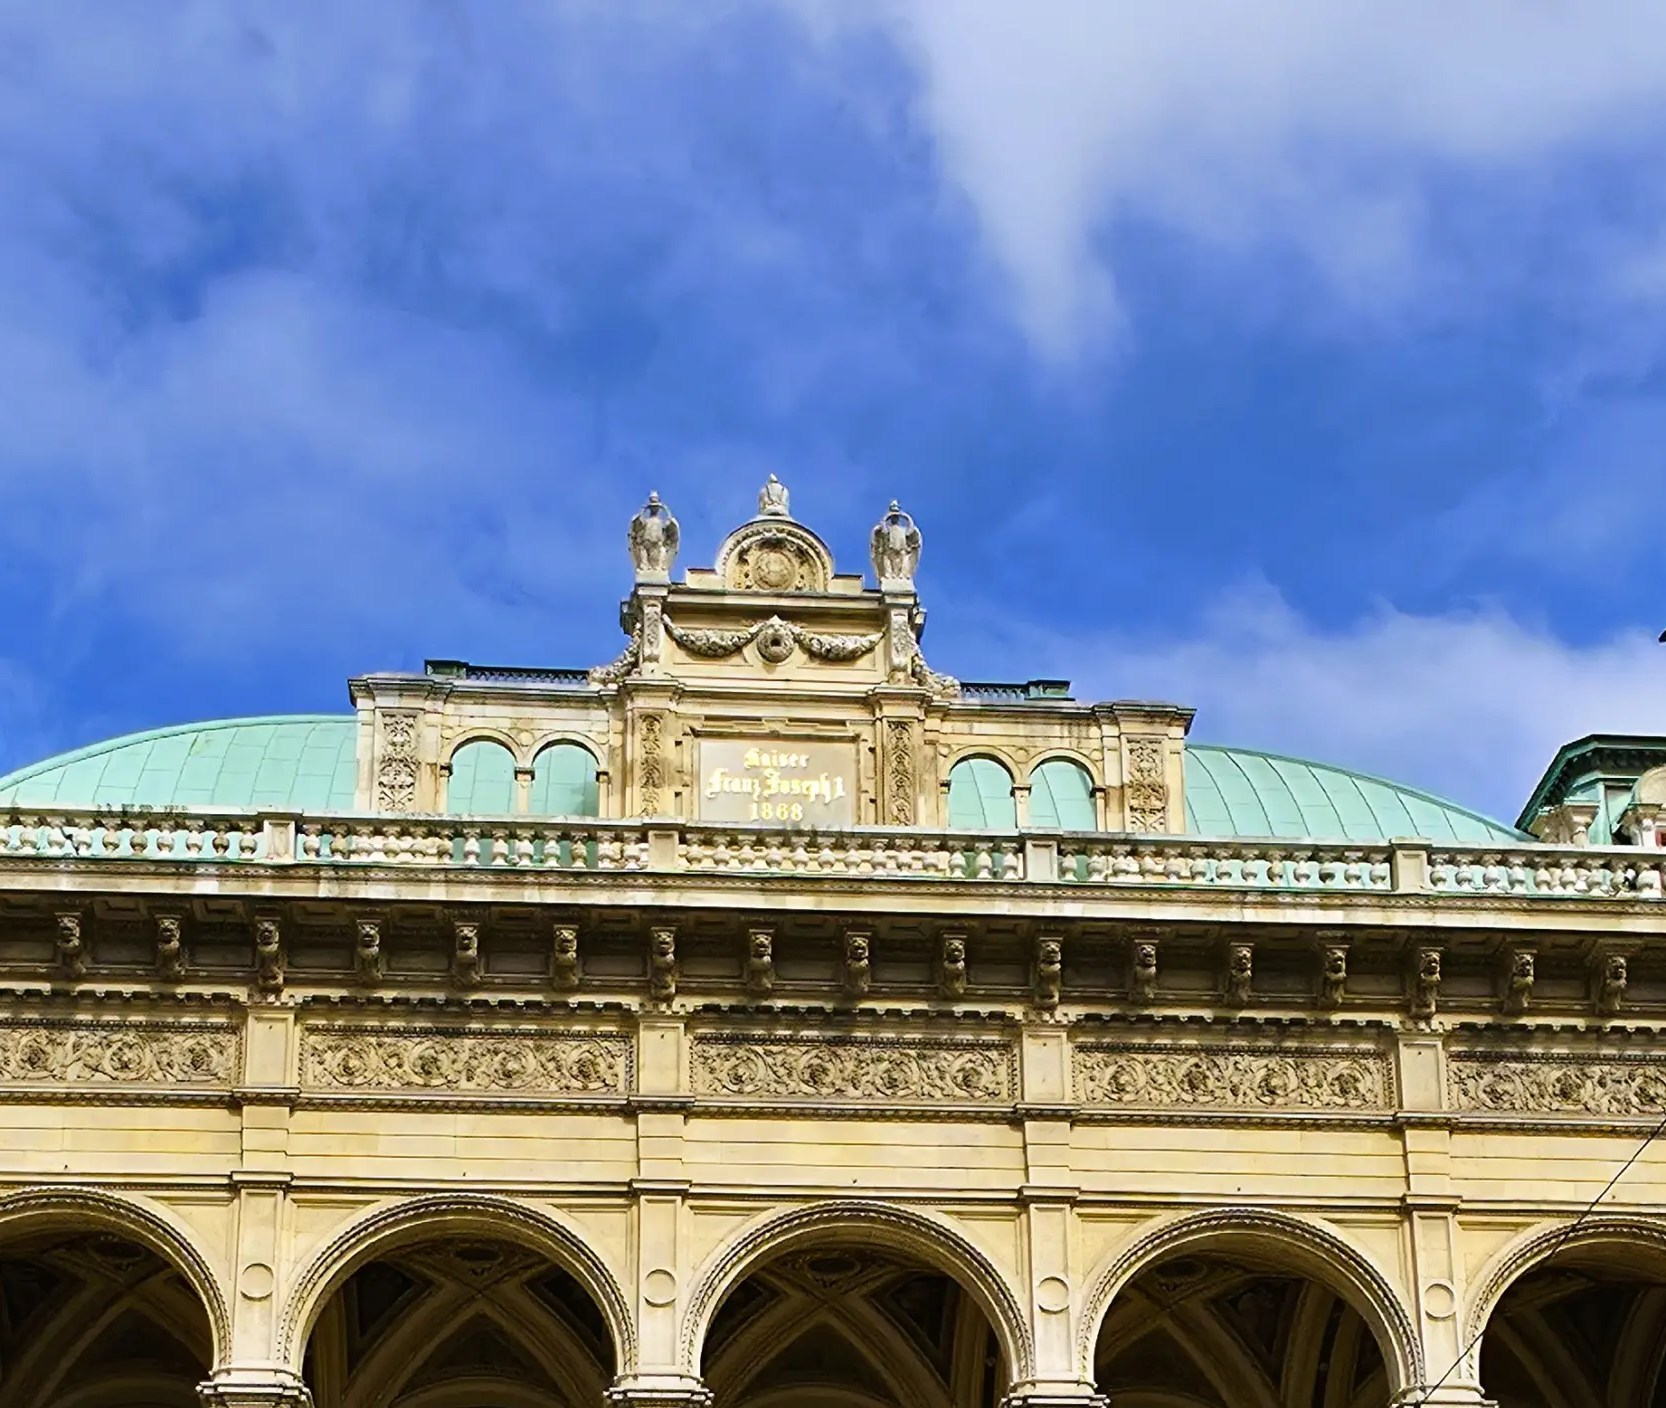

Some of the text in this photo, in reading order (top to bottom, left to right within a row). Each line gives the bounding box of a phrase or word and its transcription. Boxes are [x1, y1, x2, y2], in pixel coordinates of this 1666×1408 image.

[743, 748, 810, 769] Kaiser
[705, 767, 761, 800] Franz
[763, 768, 832, 804] Joseph
[749, 802, 804, 821] 1868
